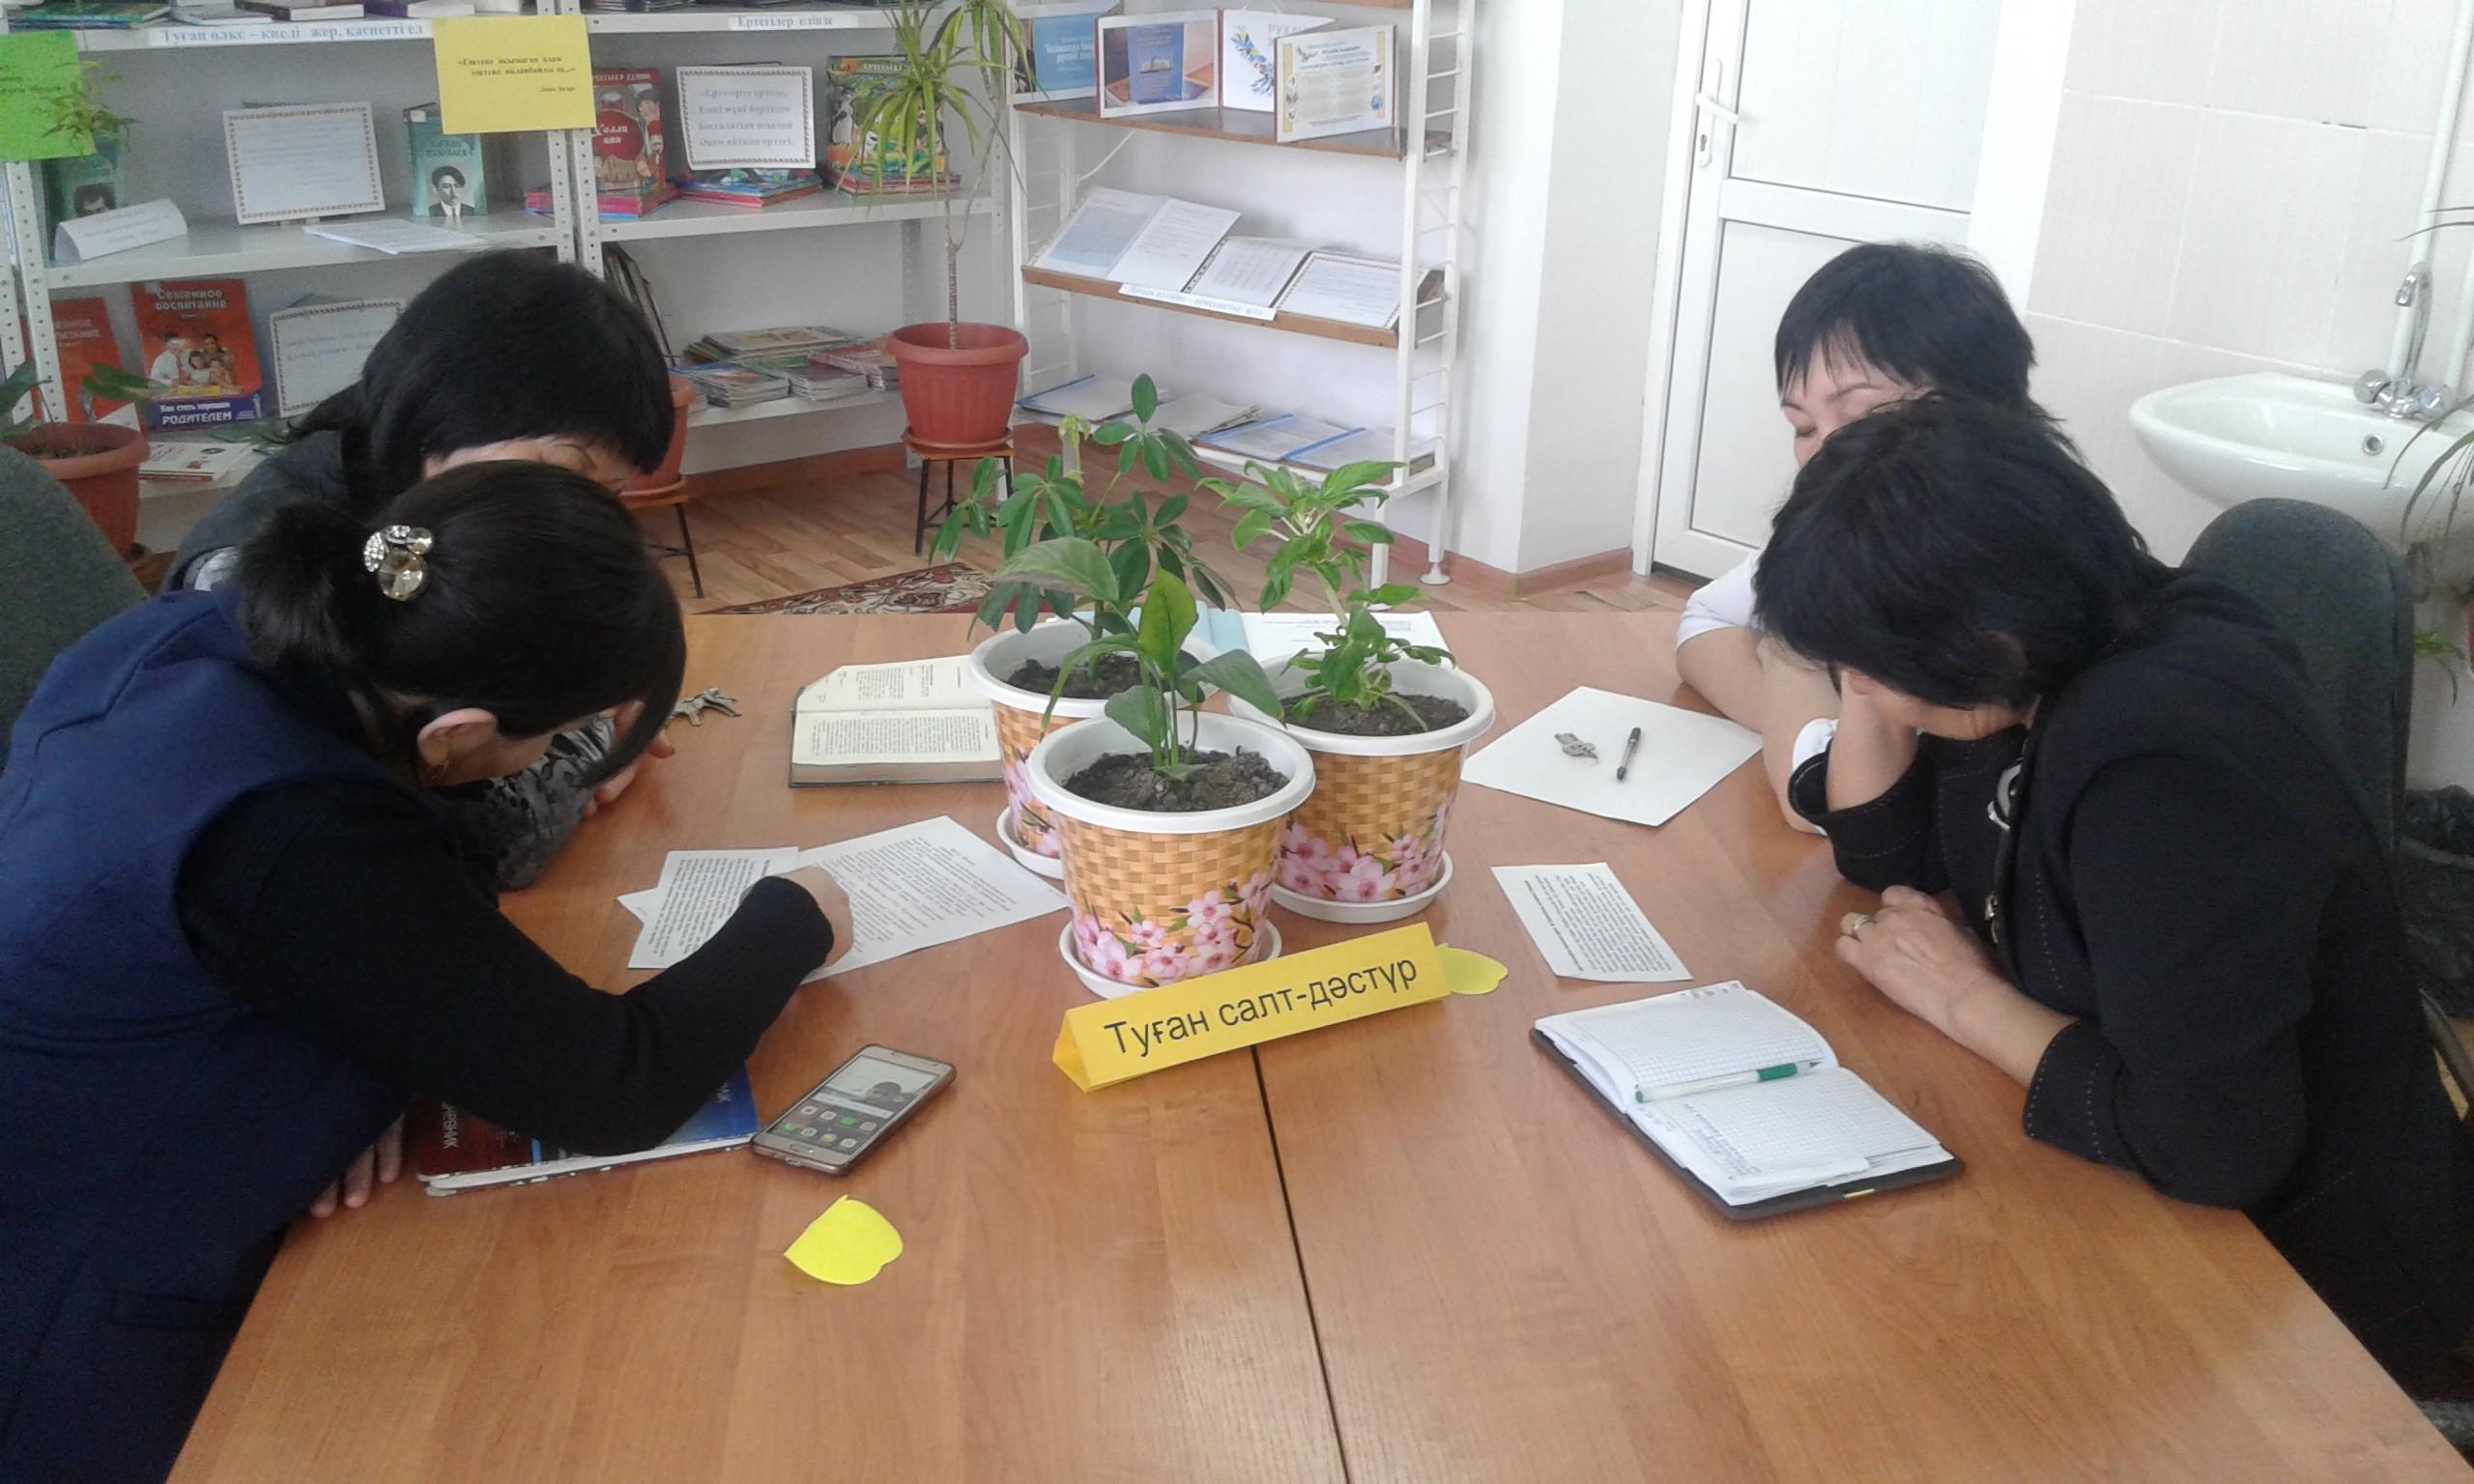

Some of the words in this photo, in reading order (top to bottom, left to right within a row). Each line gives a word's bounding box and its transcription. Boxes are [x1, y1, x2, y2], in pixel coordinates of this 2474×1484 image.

[161, 412, 233, 426] РОДИТЕЛЕМ
[1103, 1009, 1211, 1058] Туған
[1218, 958, 1418, 1030] салт-дәстүр
